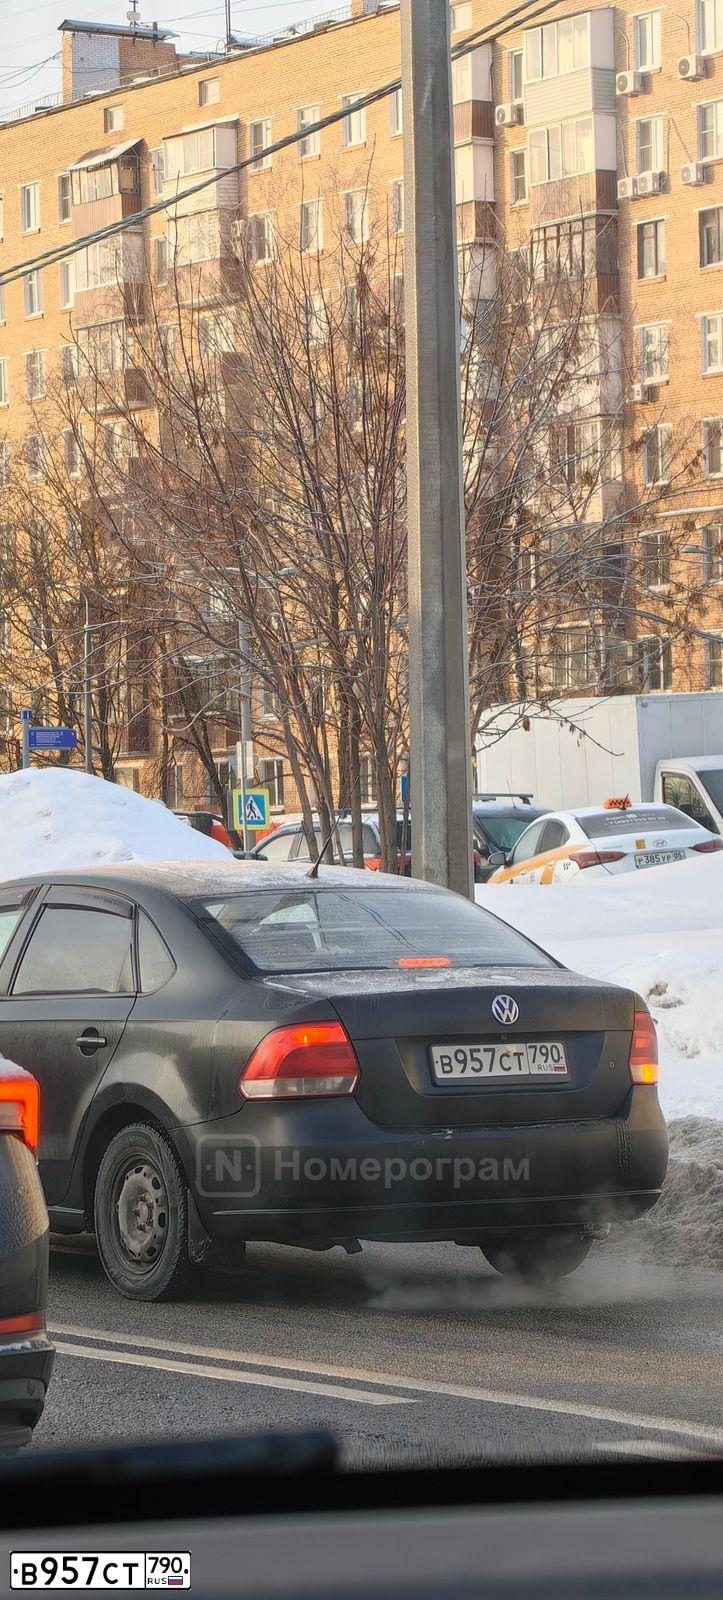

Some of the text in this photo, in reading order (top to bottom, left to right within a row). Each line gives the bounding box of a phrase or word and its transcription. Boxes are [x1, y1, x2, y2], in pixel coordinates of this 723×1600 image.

[440, 1044, 560, 1074] В957СТ 790
[537, 1063, 554, 1072] RUS
